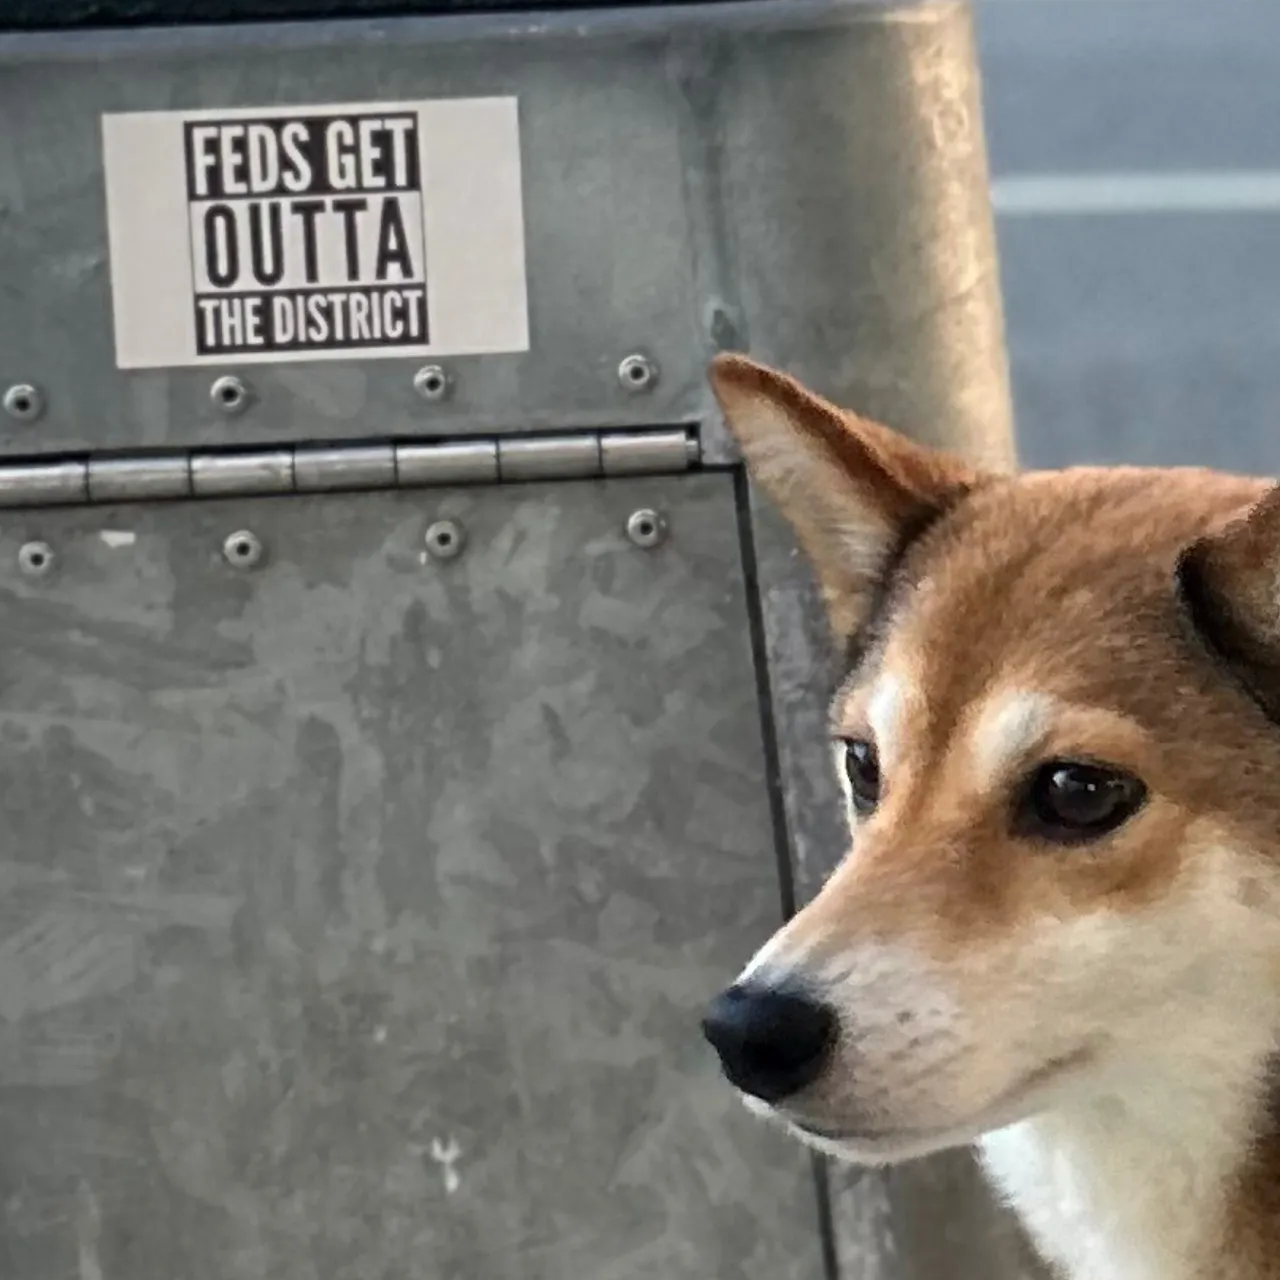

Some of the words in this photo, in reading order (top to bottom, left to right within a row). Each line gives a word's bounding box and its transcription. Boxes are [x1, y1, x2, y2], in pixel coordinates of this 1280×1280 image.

[191, 121, 312, 196] FEDS
[326, 118, 414, 190] GET
[204, 196, 414, 288] OUTTA
[199, 297, 264, 348] THE
[273, 289, 424, 344] DISTRICT
